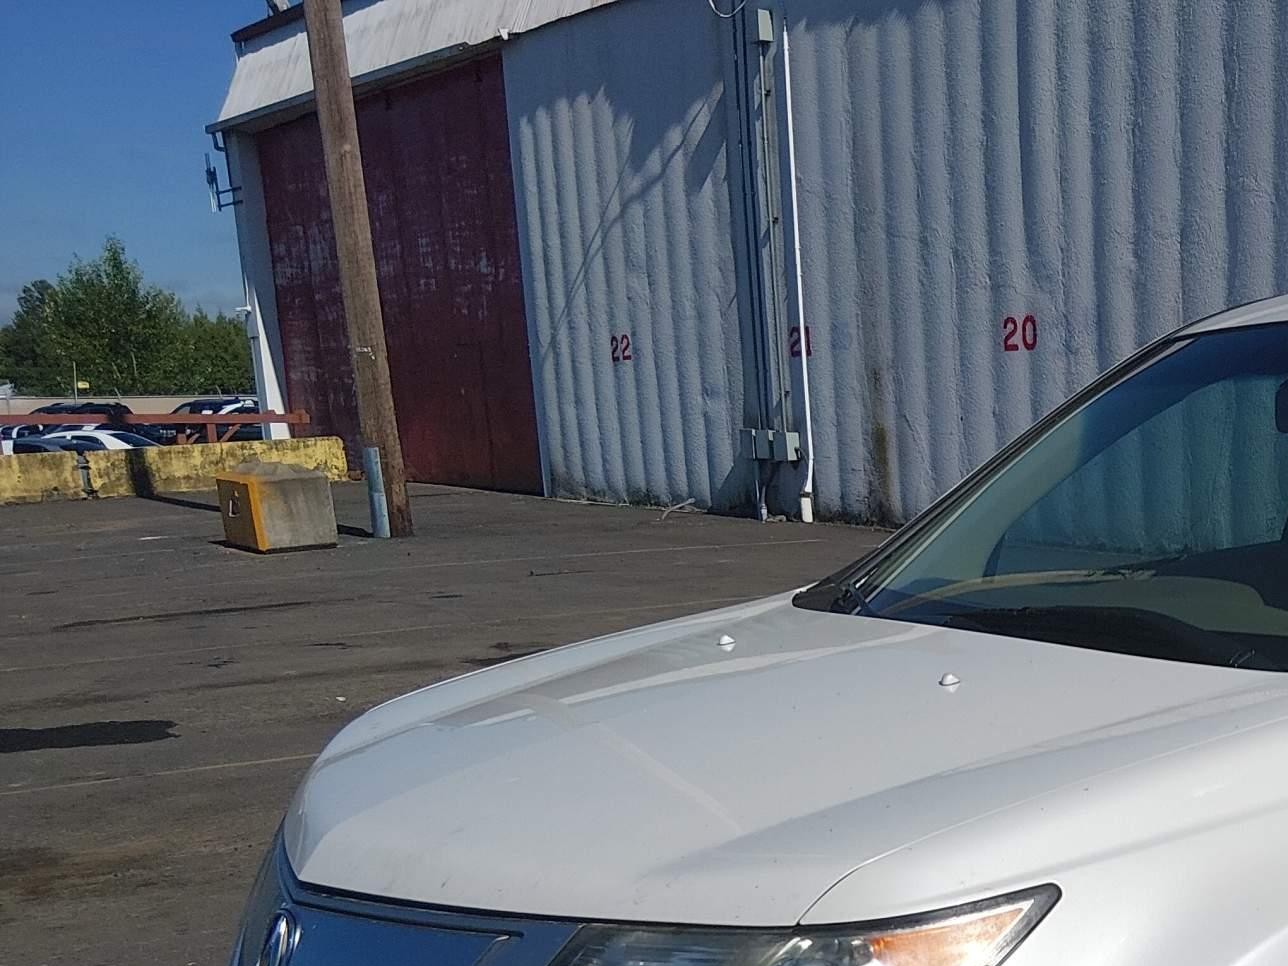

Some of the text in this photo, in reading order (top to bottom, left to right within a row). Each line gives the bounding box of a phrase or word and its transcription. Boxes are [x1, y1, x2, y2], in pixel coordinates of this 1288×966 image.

[610, 334, 632, 362] 22
[790, 326, 812, 357] 21
[1003, 314, 1037, 351] 20
